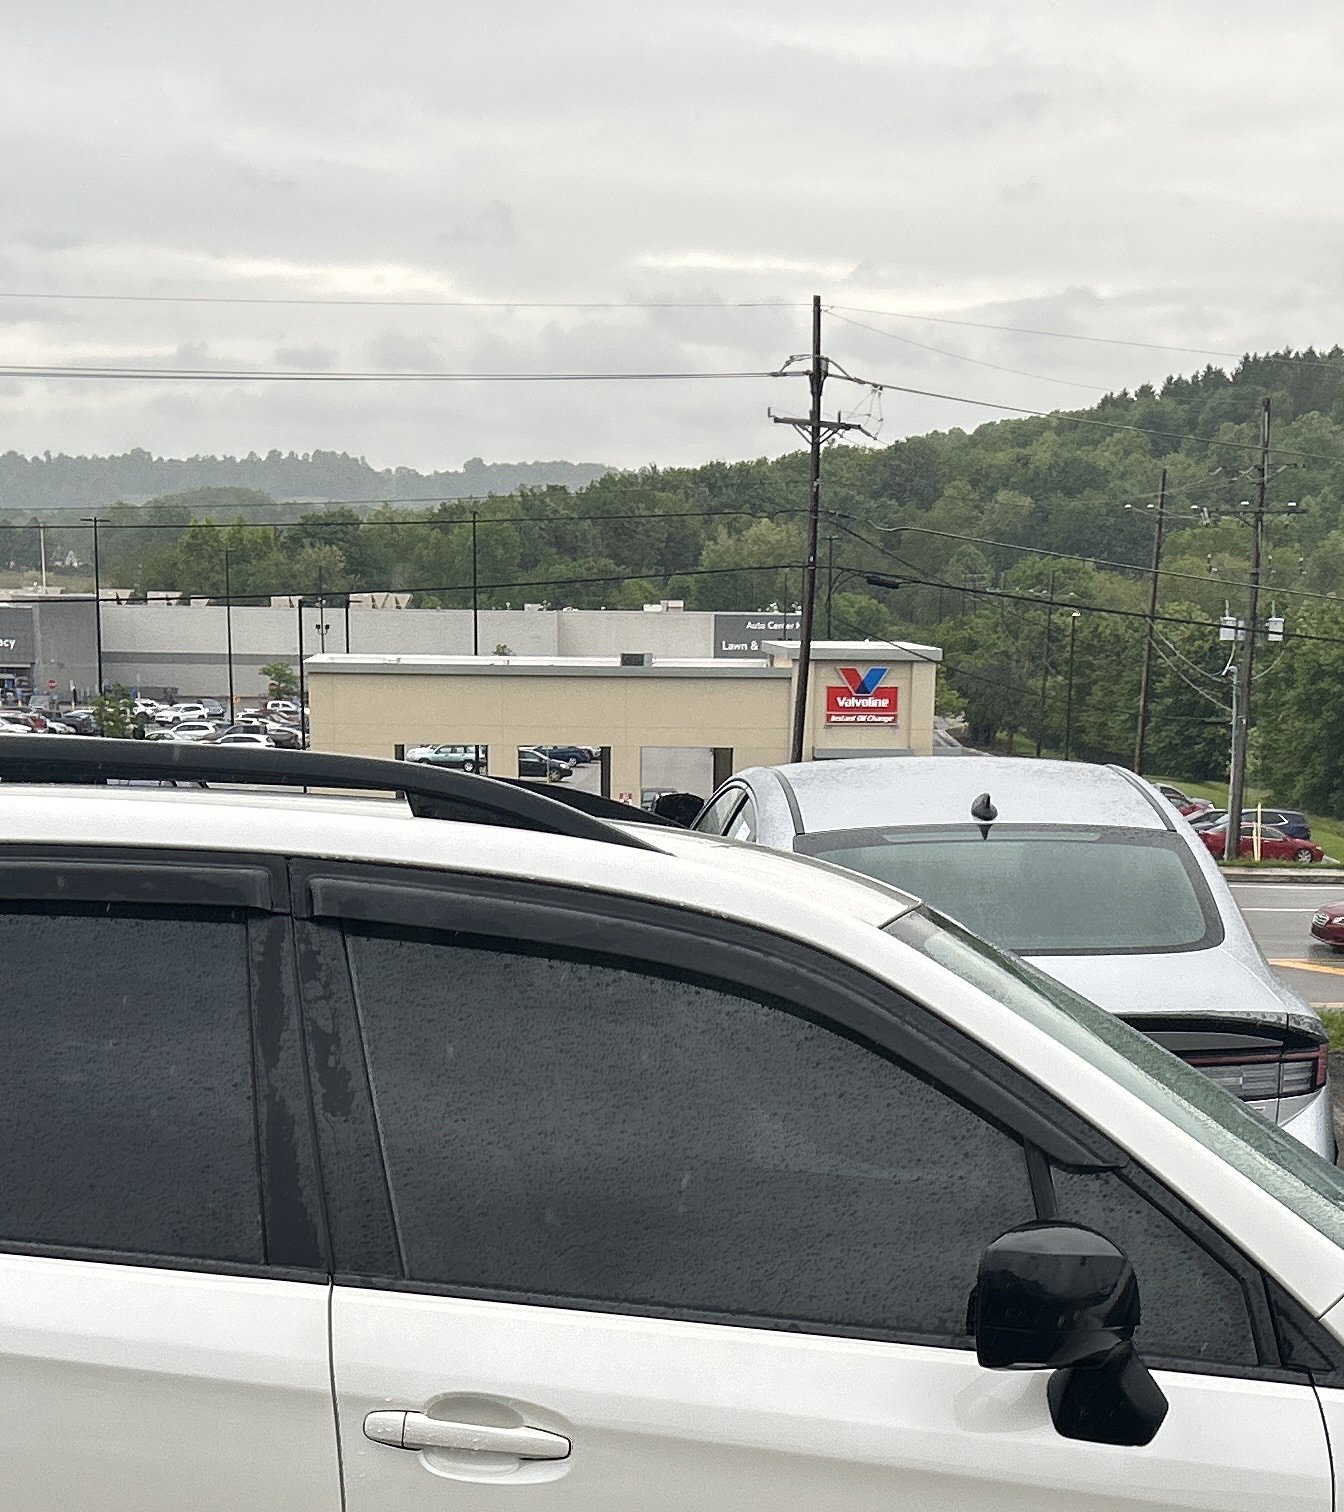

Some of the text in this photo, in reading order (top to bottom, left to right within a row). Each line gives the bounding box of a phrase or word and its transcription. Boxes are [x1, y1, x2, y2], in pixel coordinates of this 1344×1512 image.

[746, 621, 766, 630] Auto
[721, 640, 759, 650] Lawn &
[836, 696, 890, 708] Valvoline
